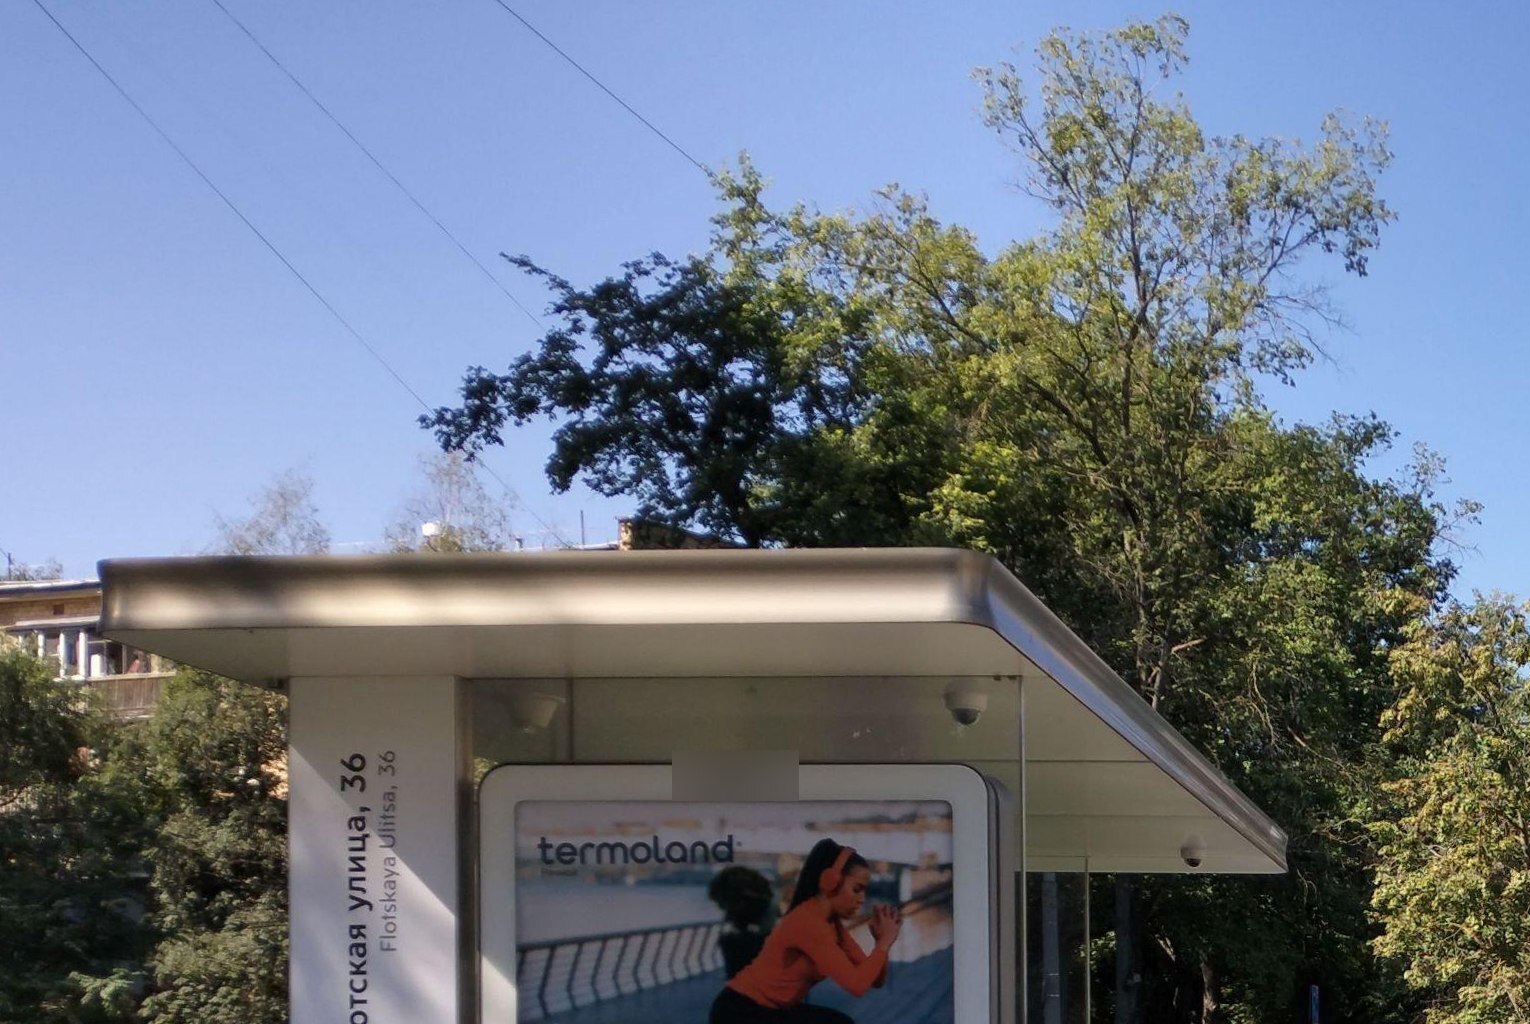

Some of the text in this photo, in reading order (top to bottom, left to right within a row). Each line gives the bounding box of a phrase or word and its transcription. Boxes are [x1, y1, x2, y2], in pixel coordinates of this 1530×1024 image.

[340, 752, 367, 793] 36
[347, 806, 374, 912] улица,
[378, 750, 400, 952] Flotskaya Ulitsa, 36
[537, 834, 734, 866] termoland
